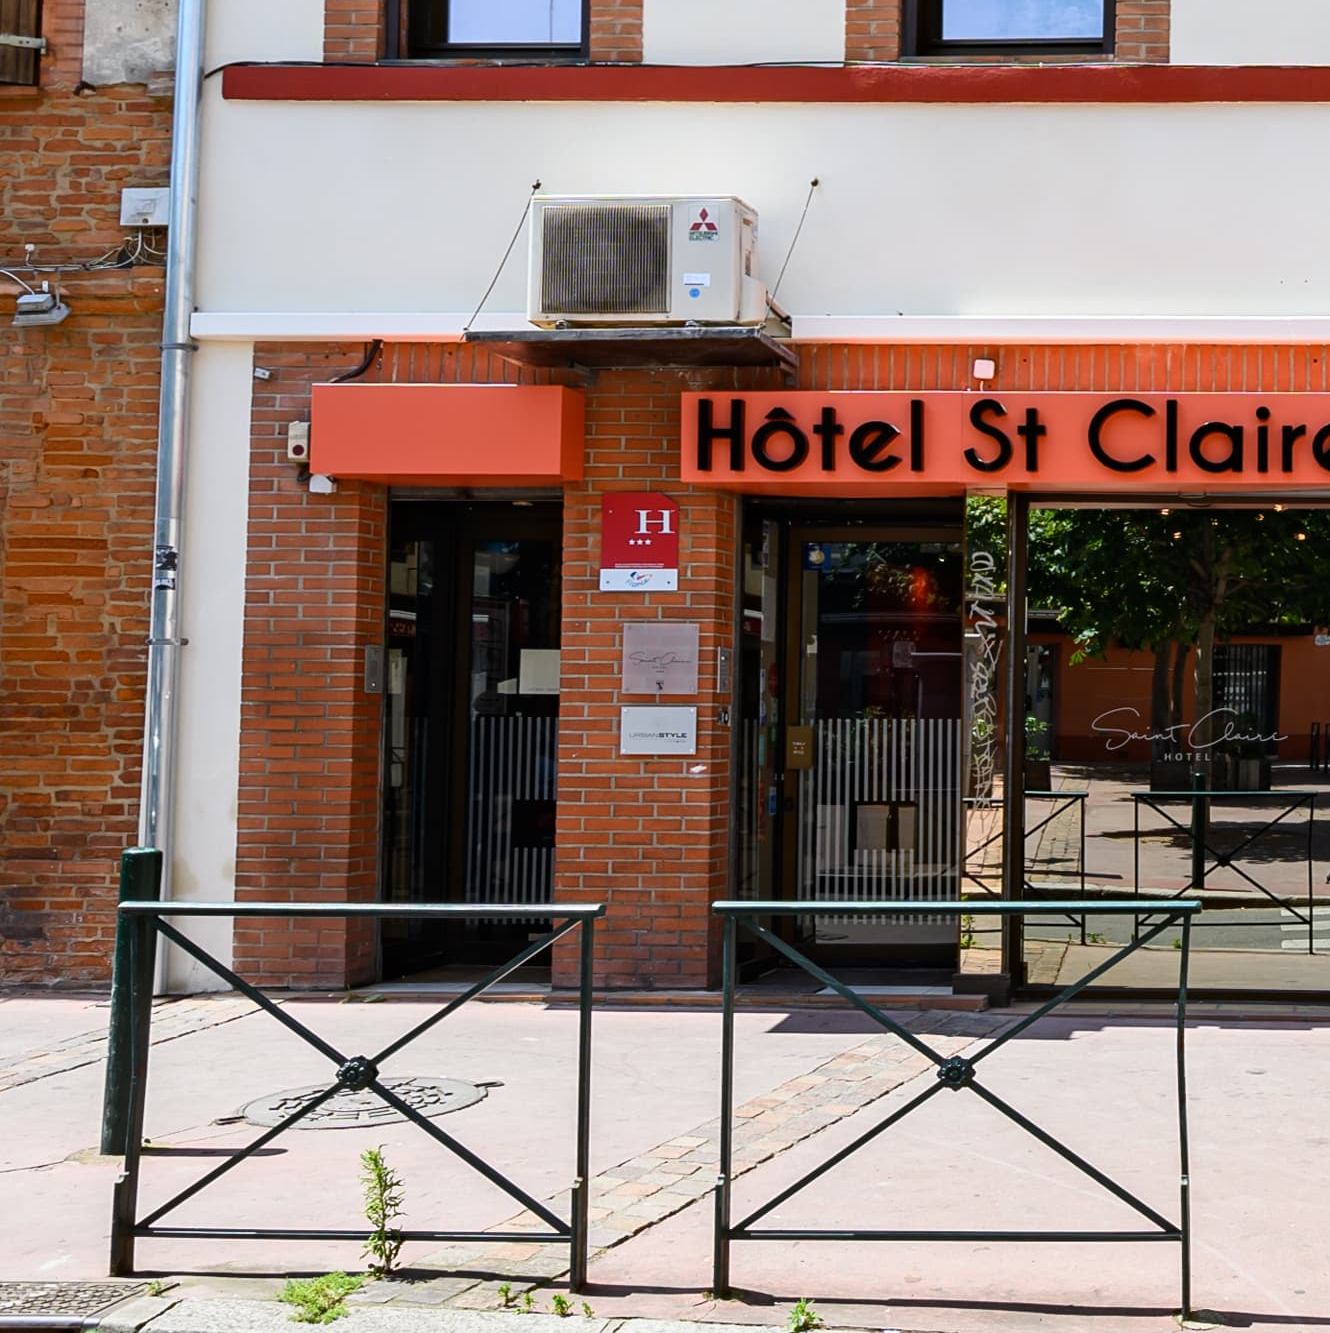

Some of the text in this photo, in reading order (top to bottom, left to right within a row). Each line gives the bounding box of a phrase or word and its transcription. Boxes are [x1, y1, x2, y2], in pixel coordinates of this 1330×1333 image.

[697, 398, 925, 473] Hôtel
[963, 398, 1047, 473] St
[634, 509, 675, 534] H
[1090, 706, 1289, 751] Saint Claire
[1163, 752, 1212, 762] HOTEL
